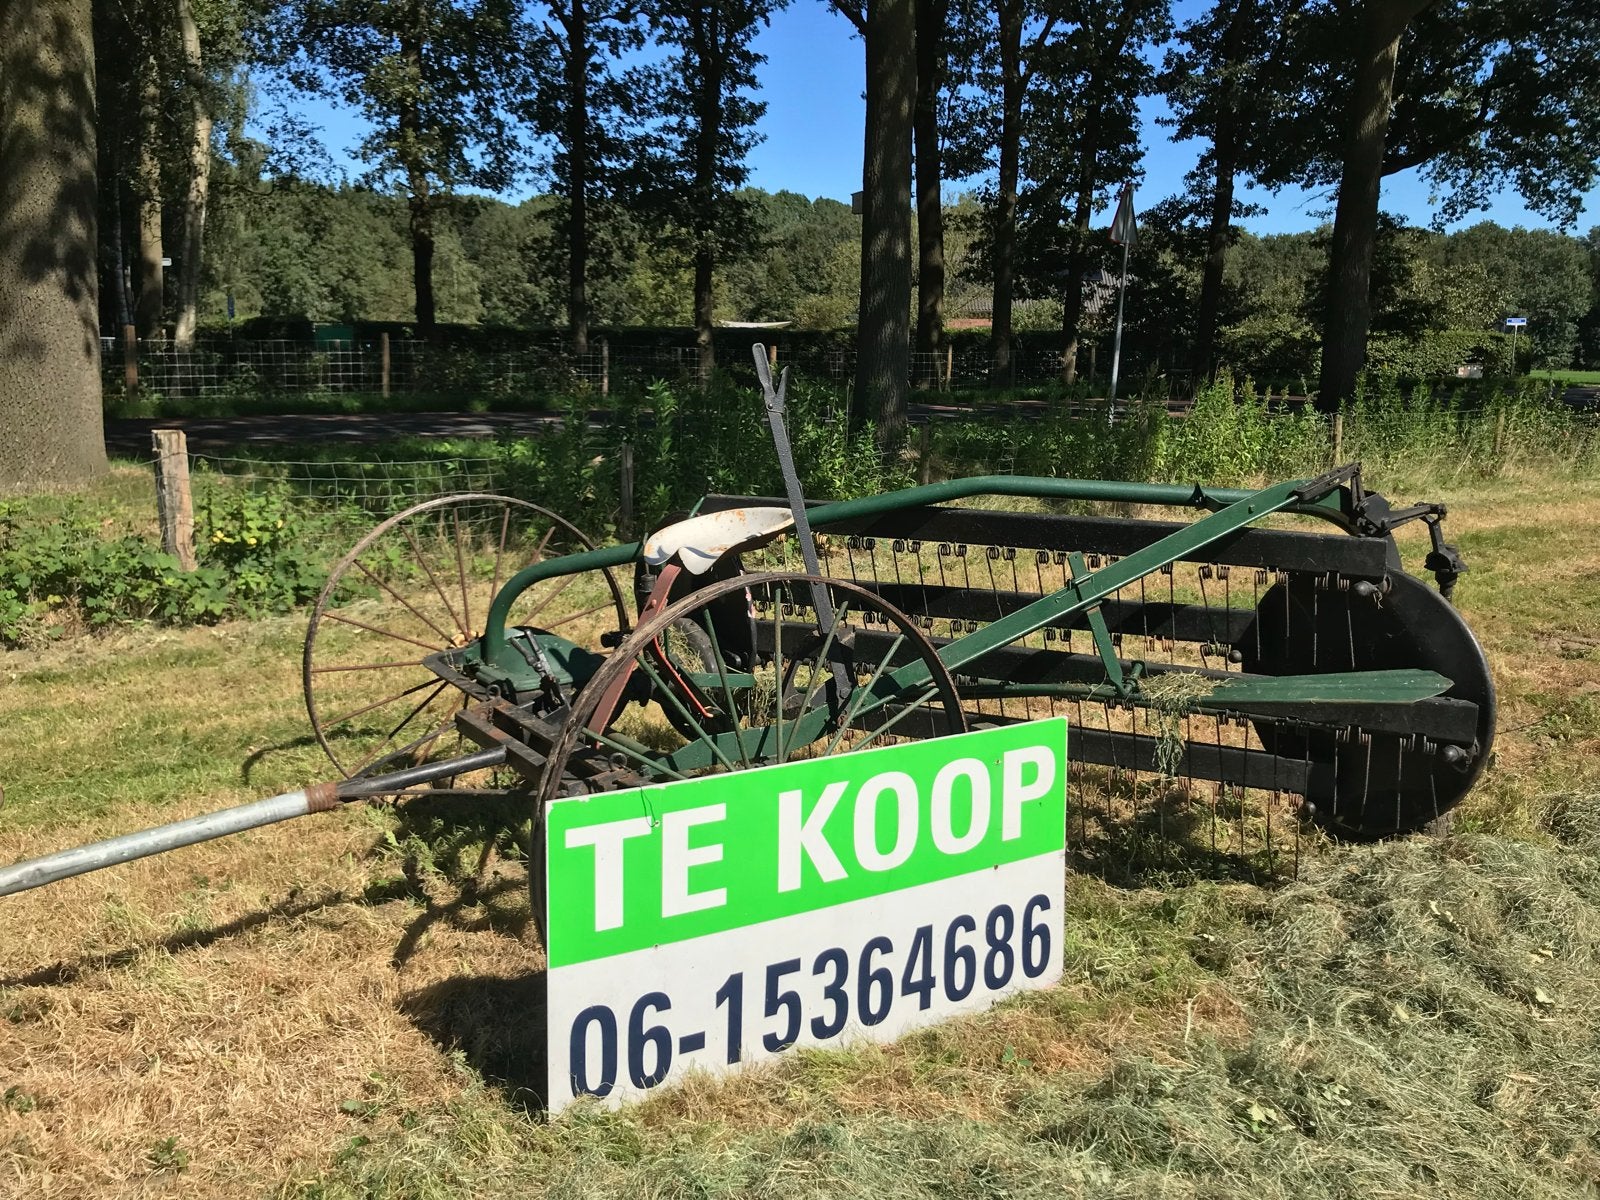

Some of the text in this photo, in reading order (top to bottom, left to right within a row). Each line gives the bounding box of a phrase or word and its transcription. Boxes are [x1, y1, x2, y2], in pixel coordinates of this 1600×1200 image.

[565, 745, 1056, 932] TE KOOP
[569, 893, 1051, 1099] 06-15364686
